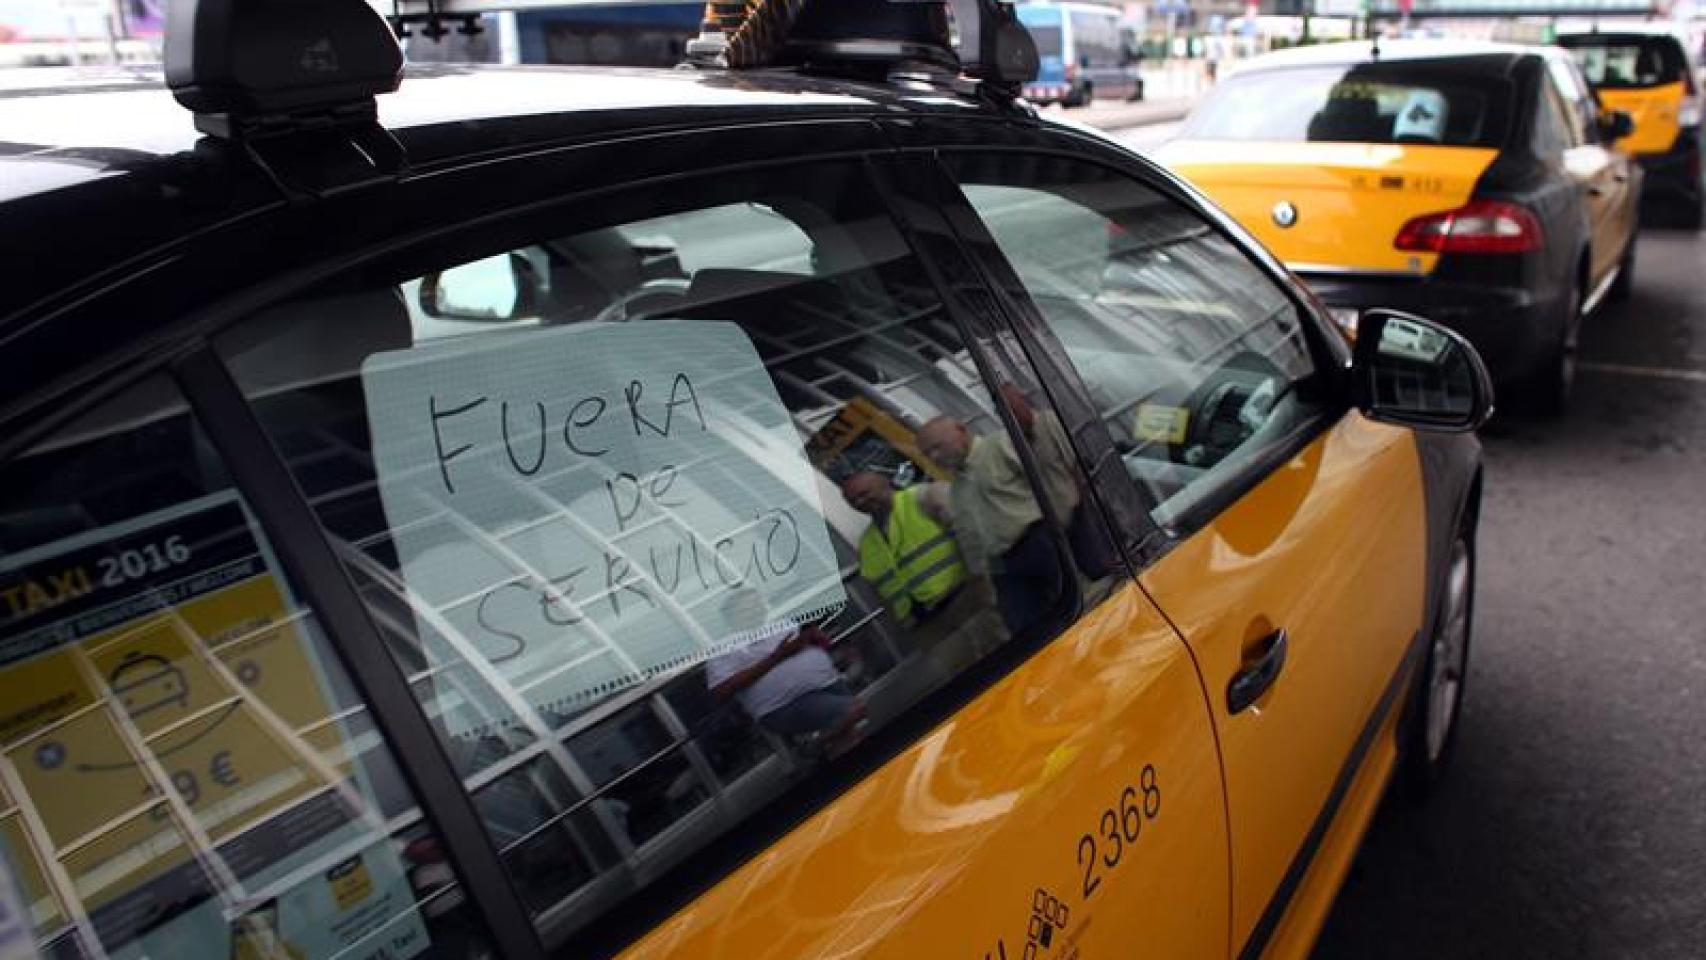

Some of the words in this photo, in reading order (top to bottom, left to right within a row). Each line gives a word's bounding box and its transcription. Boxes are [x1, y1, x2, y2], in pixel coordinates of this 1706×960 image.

[1, 567, 93, 618] TAXI
[98, 534, 192, 588] 2016
[1077, 763, 1161, 899] 2368
